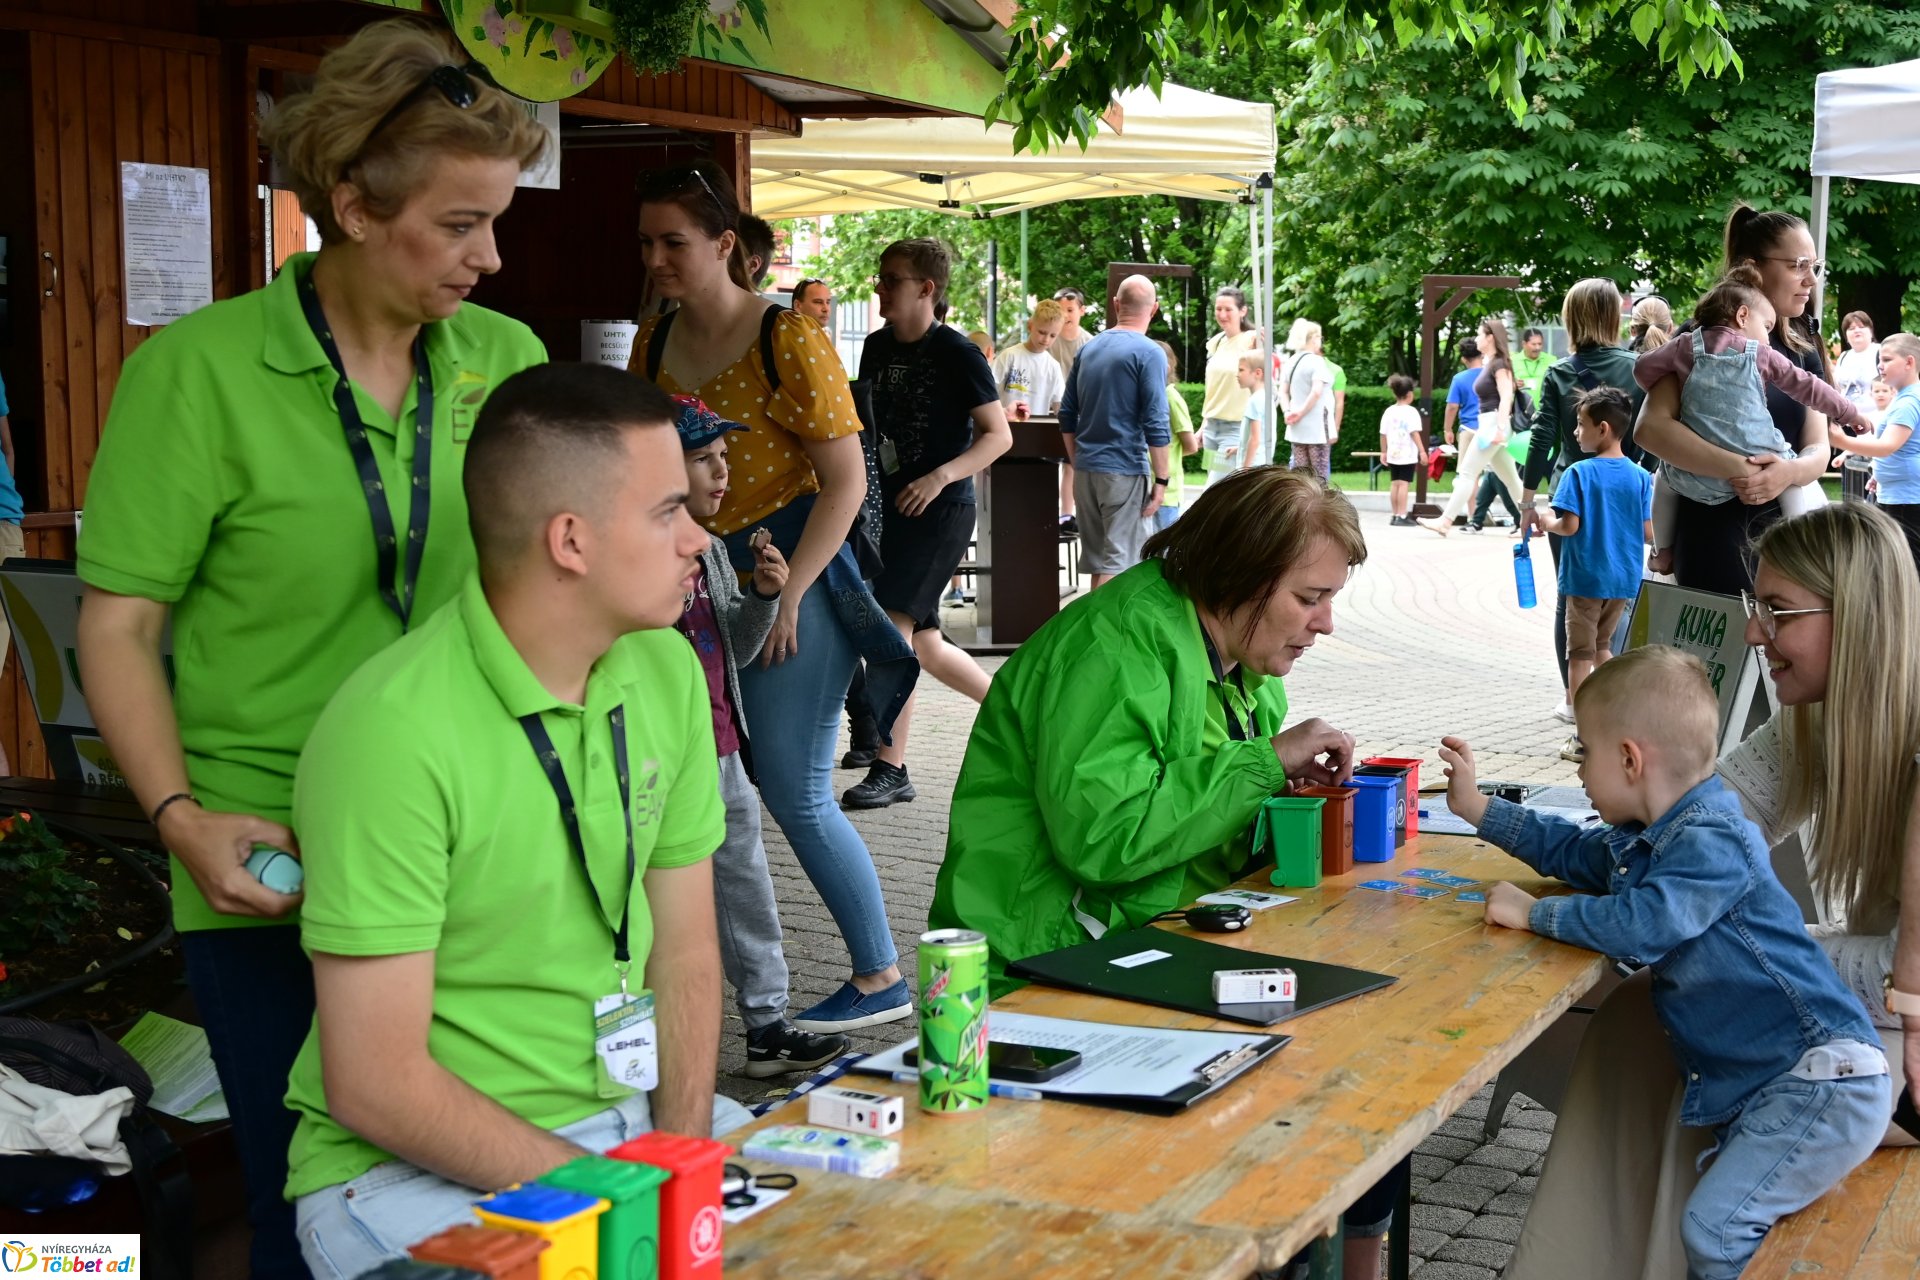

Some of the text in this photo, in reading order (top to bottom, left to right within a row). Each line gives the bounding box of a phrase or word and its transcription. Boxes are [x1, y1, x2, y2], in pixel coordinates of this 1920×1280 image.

[601, 353, 629, 361] KASSZA
[1673, 604, 1727, 650] KUKA
[607, 1038, 650, 1052] LEHEL
